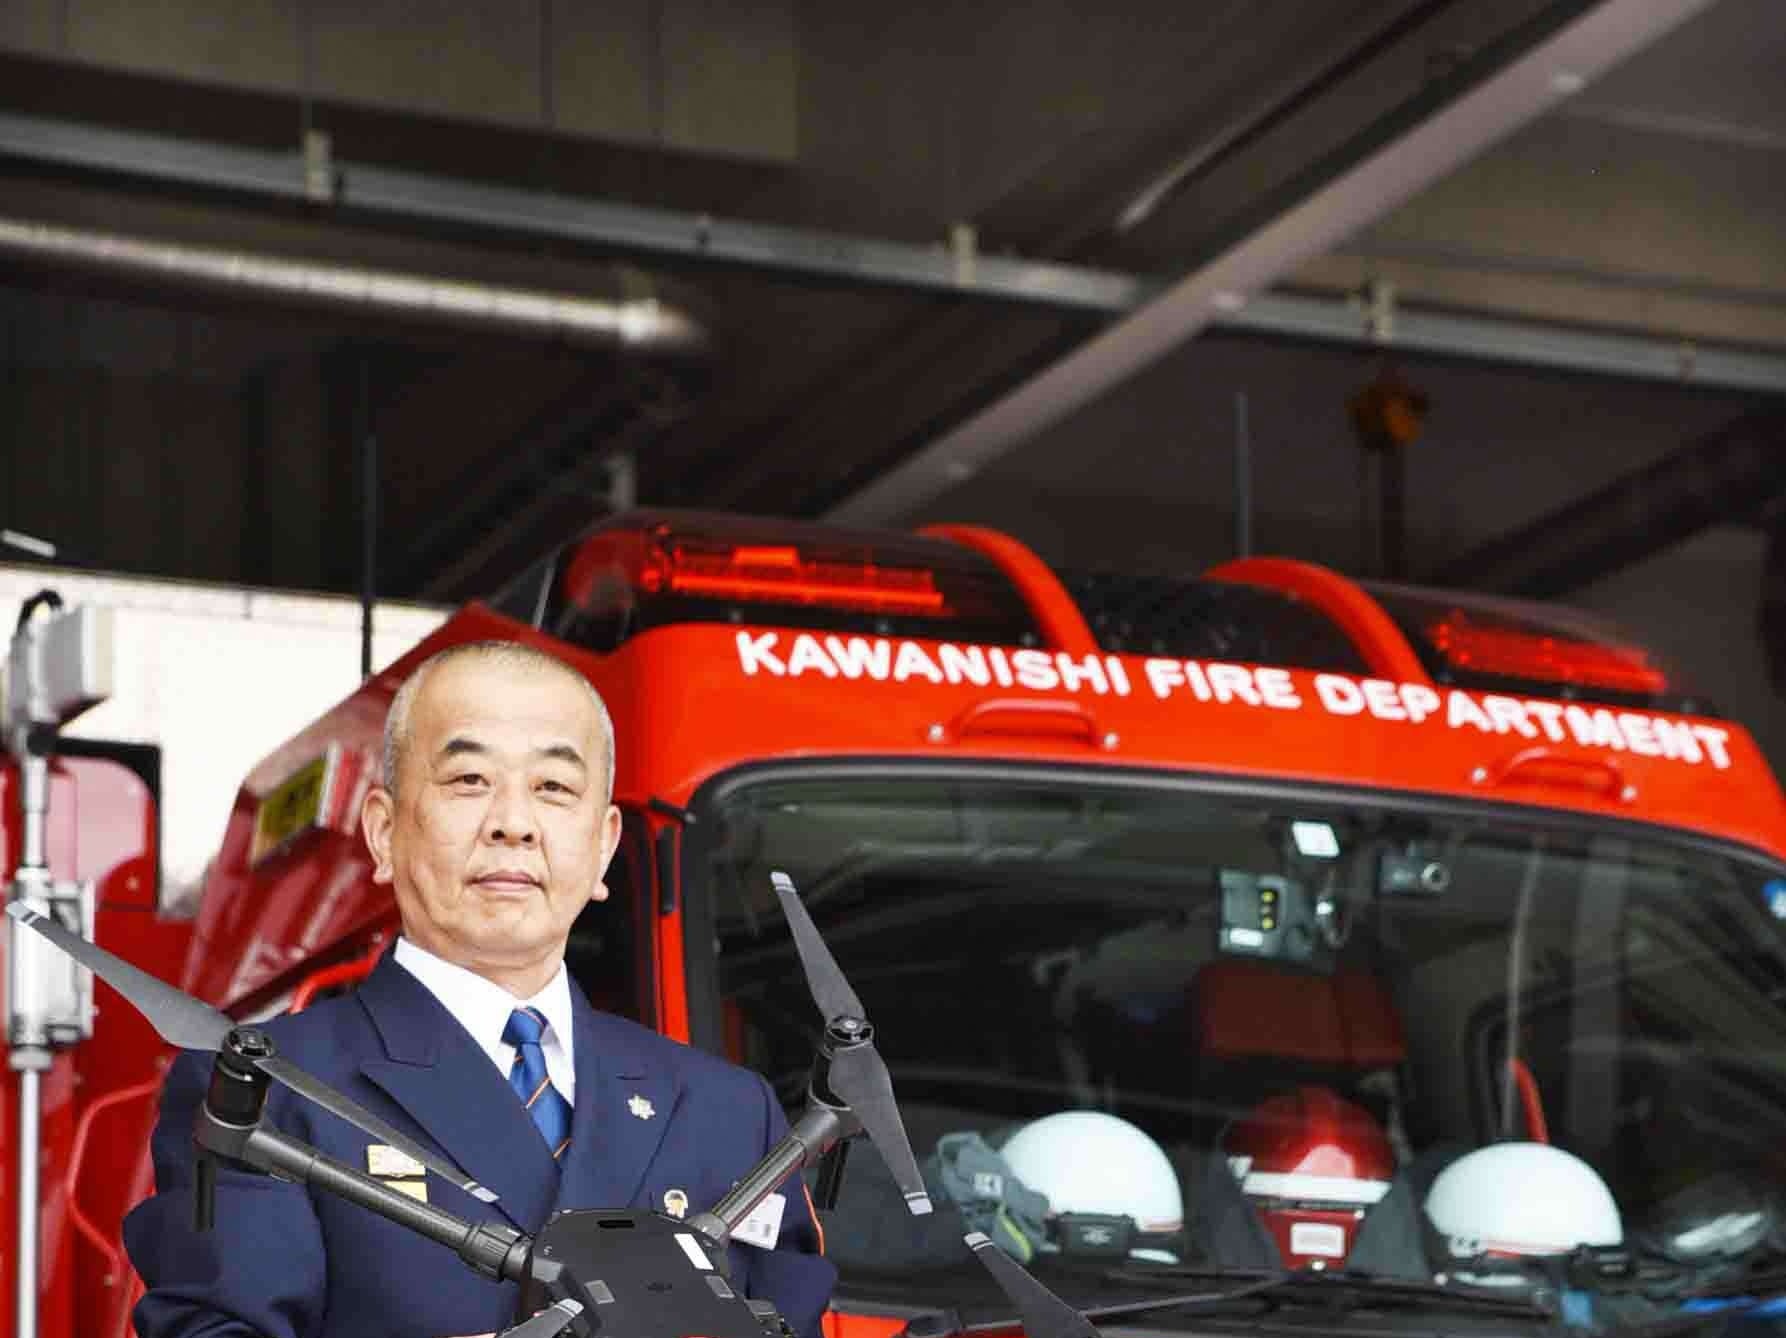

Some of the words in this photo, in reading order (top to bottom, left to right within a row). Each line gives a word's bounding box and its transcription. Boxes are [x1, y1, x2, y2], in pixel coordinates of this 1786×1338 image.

[735, 630, 1131, 696] KAWANISHI
[1144, 657, 1301, 709] FIRE
[1314, 673, 1730, 769] DEPARTMENT
